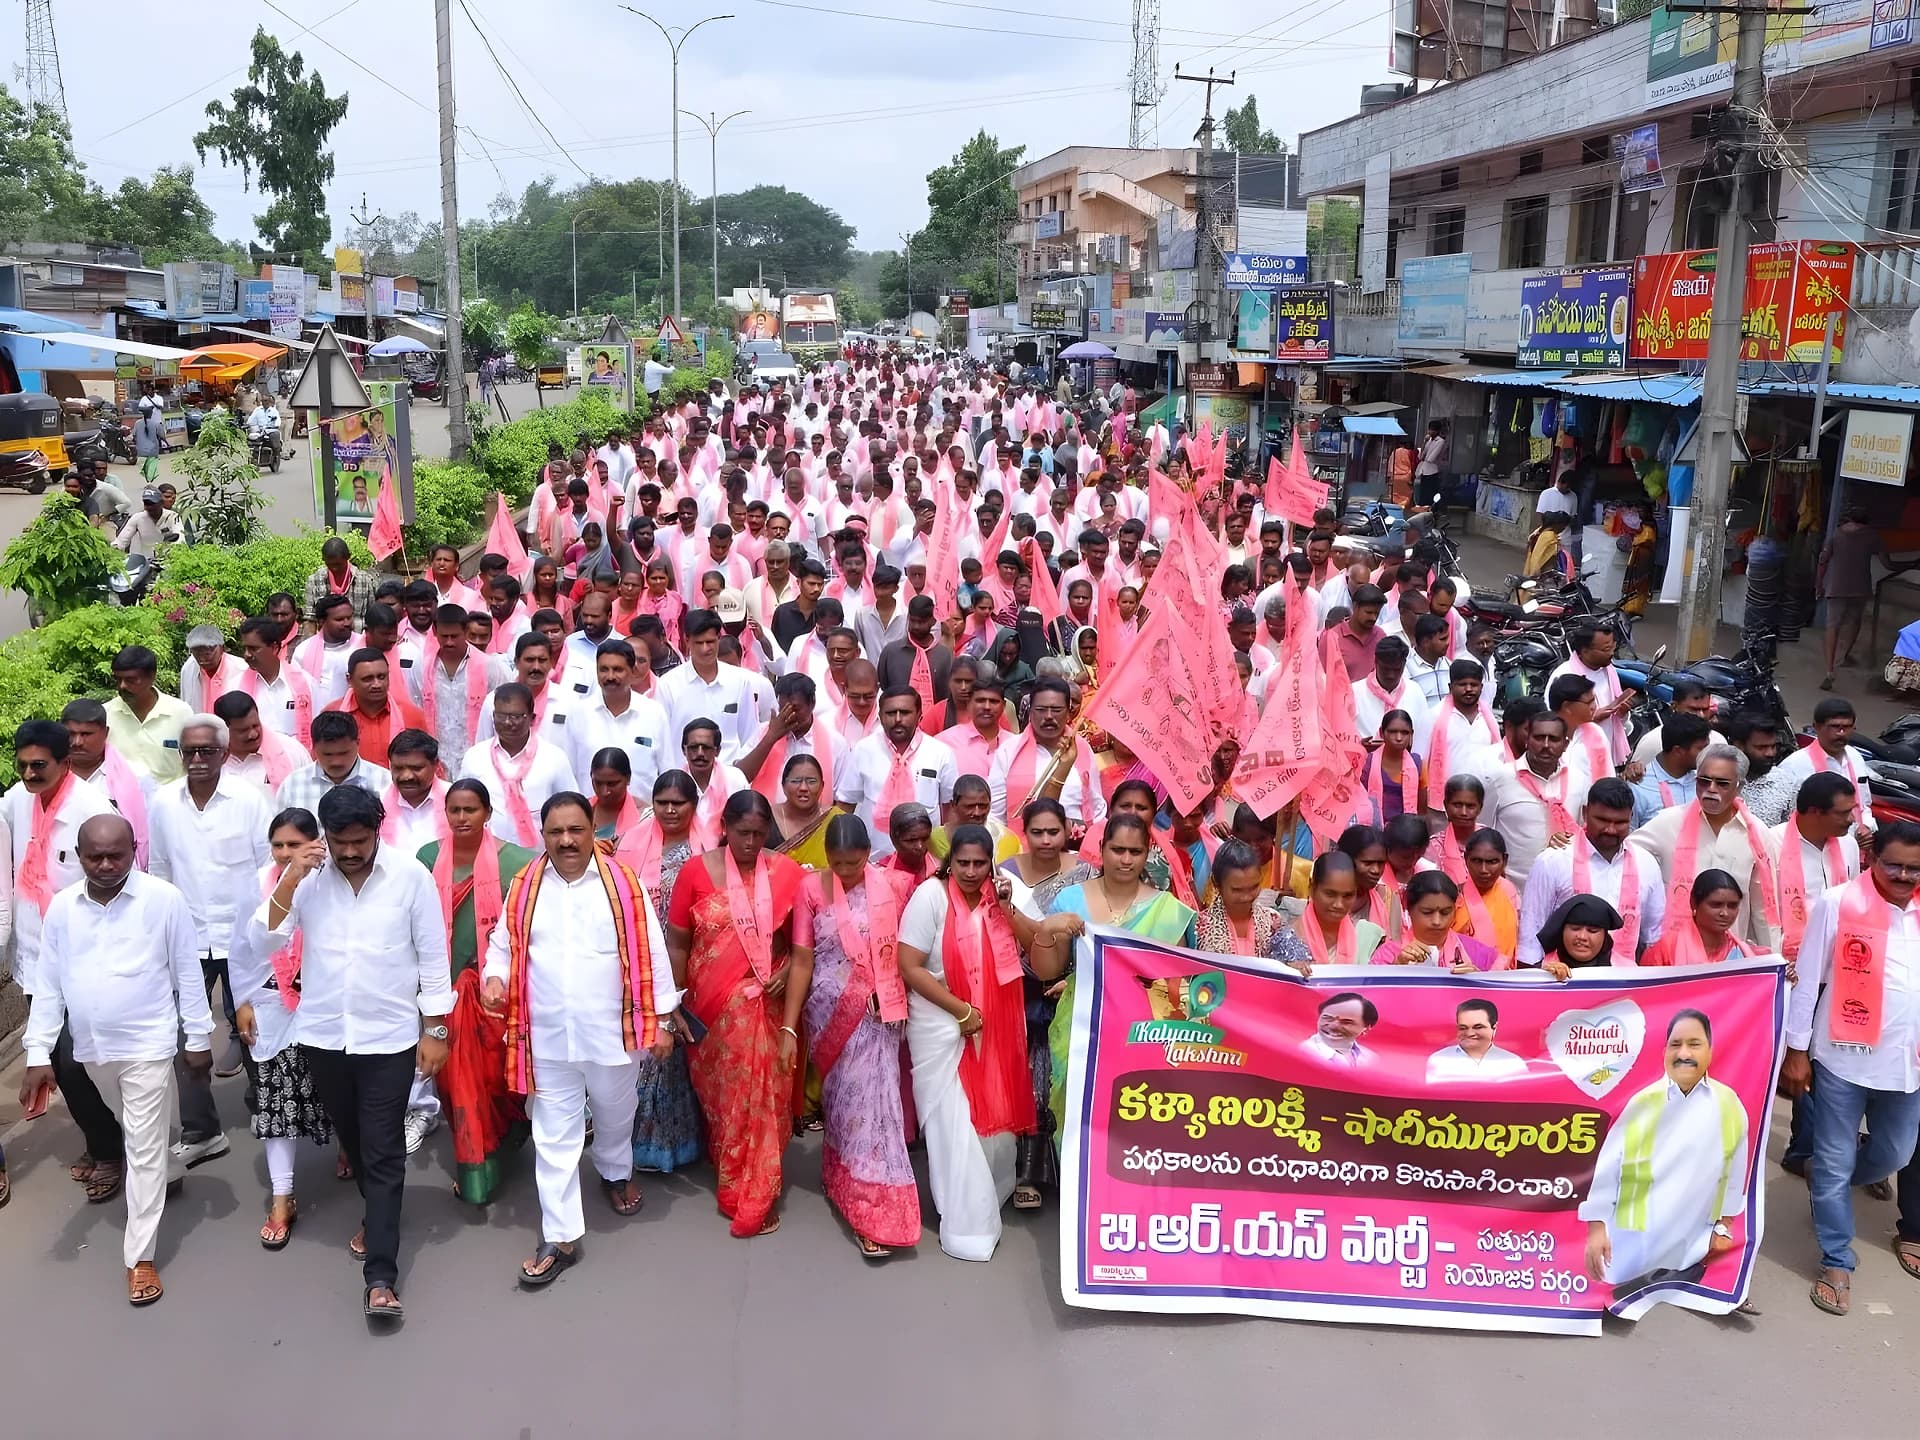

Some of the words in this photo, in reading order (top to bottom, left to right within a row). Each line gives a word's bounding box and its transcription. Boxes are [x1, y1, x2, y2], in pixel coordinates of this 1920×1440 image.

[1135, 1021, 1212, 1047] Kalyana
[1569, 1024, 1619, 1040] Shaadi
[1444, 1263, 1535, 1291] నియోజక
[1540, 1268, 1588, 1305] వర్గం
